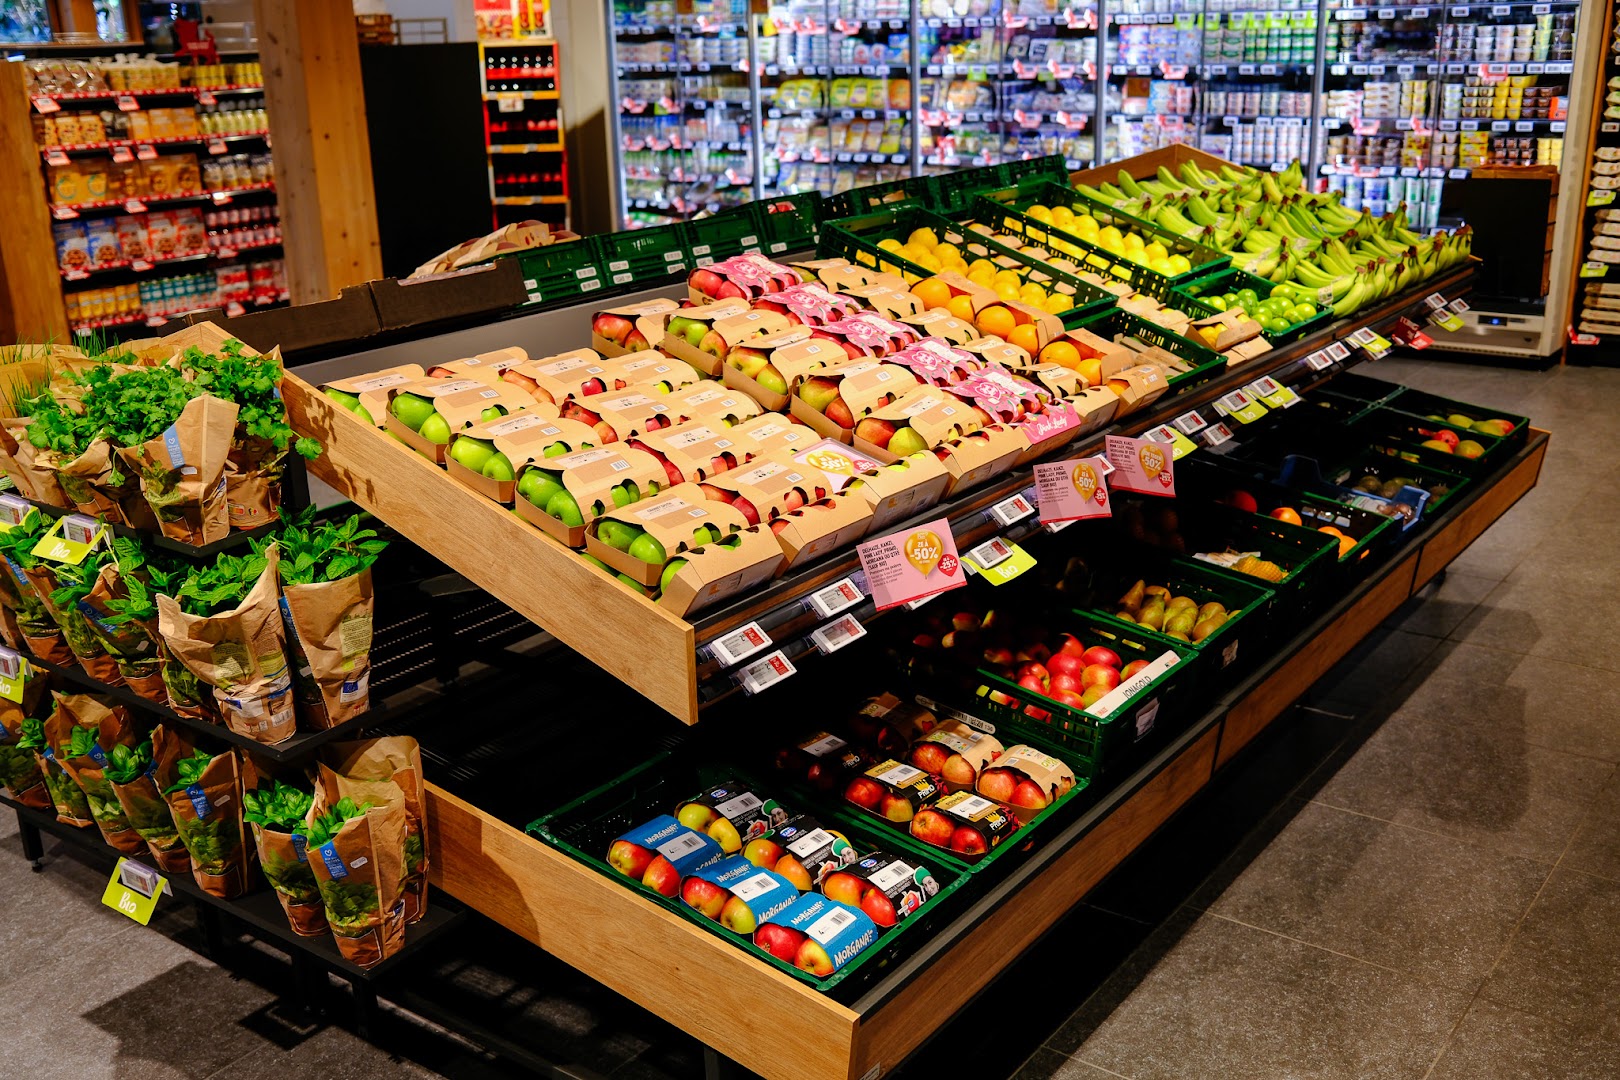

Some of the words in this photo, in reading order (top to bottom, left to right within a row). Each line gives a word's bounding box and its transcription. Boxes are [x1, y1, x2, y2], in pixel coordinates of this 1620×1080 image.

[1037, 420, 1054, 435] Pink
[1142, 456, 1161, 470] -50%
[1076, 477, 1094, 489] -50%
[50, 542, 70, 558] Bio
[862, 544, 880, 554] DELHAIZE,
[880, 541, 894, 549] KANZI,
[910, 547, 938, 560] -50%
[866, 555, 884, 565] MORGANA
[940, 559, 957, 570] -25%
[994, 565, 1019, 579] Bio
[1123, 675, 1152, 699] JONAGOLD
[918, 784, 935, 799] PRIMO
[989, 815, 1006, 830] PRIMO
[645, 823, 678, 844] MORGANA
[716, 864, 750, 882] MORGANA
[118, 892, 136, 913] Bio
[758, 896, 796, 924] MORGANA
[791, 901, 824, 925] MORGANA
[834, 931, 872, 968] MORGANA
